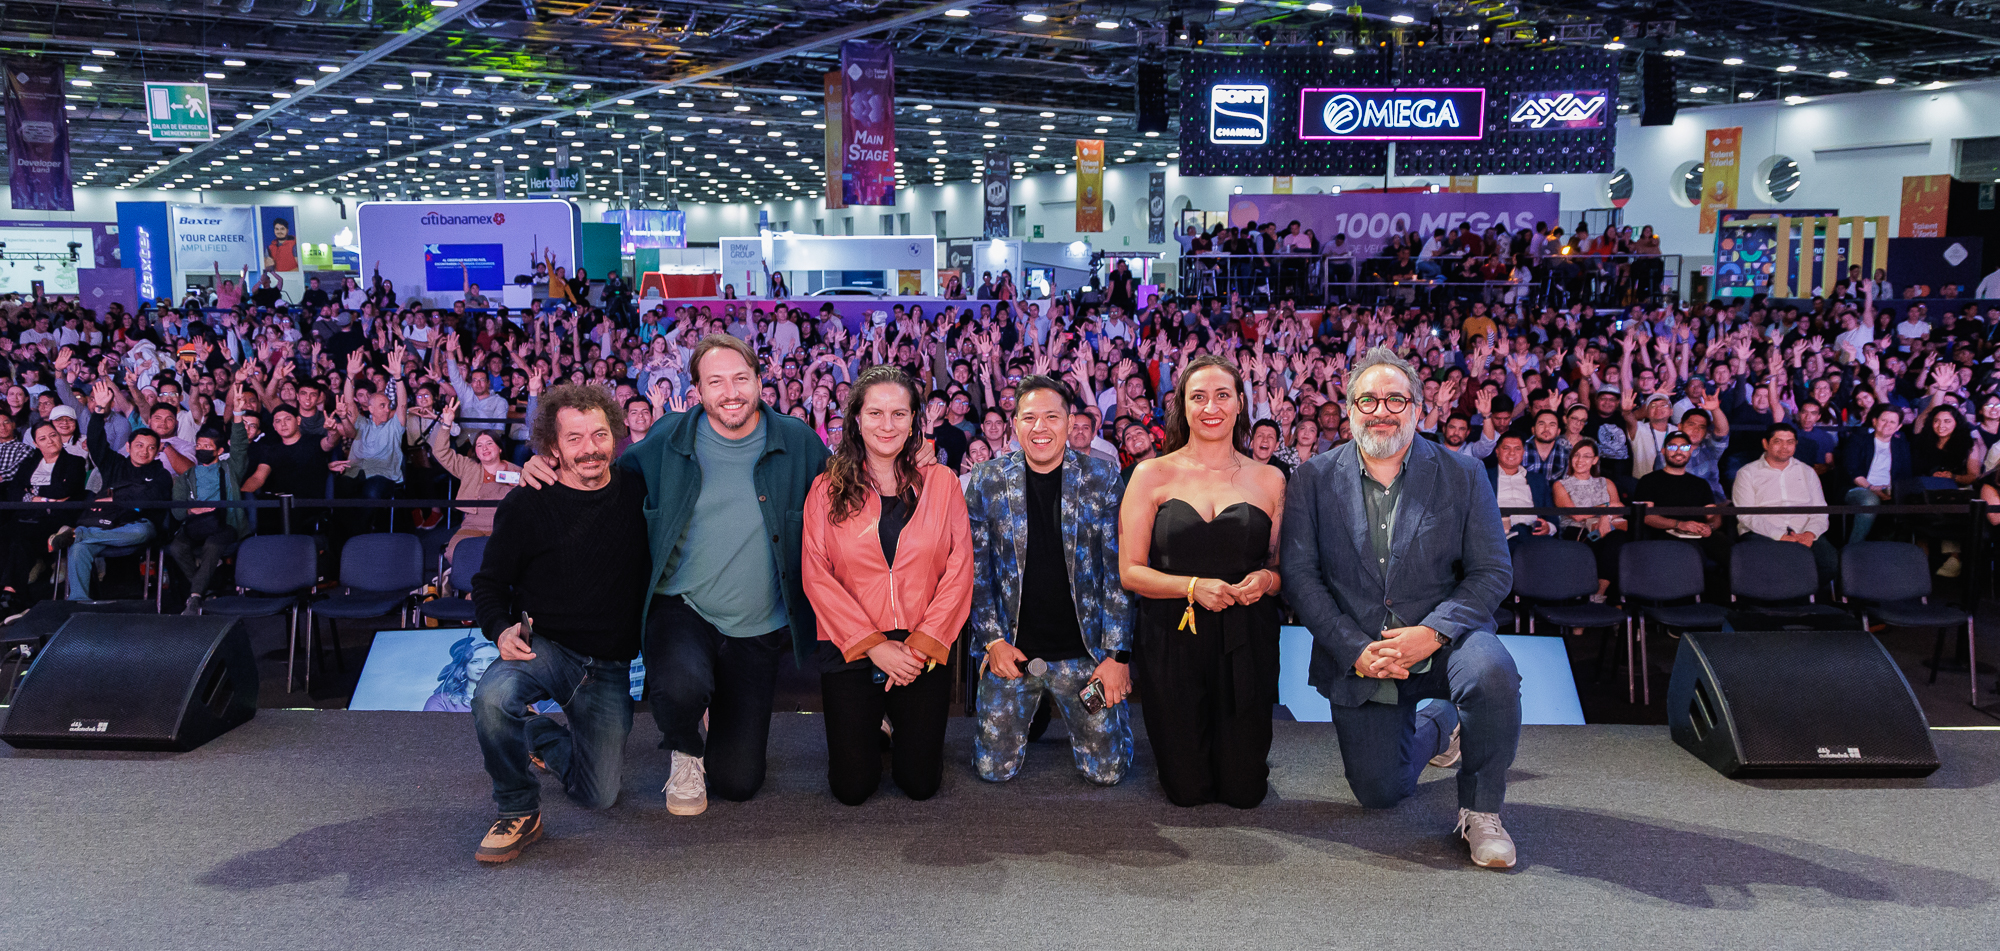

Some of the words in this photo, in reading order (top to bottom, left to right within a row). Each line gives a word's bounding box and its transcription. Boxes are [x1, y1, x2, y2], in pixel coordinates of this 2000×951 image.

[1215, 89, 1265, 104] SONY
[1362, 98, 1459, 128] MEGA
[1510, 93, 1606, 129] AXN
[853, 130, 884, 145] MAIN
[1215, 127, 1262, 138] CHANNEL
[848, 143, 890, 162] STAGE
[1710, 150, 1735, 158] Talent
[17, 158, 62, 168] Developer
[1080, 159, 1099, 167] Talent
[1709, 158, 1735, 167] World
[32, 166, 51, 174] Land
[530, 177, 576, 189] Herbalife
[179, 217, 222, 226] Baxter
[420, 211, 493, 226] citibanamex
[1335, 212, 1411, 239] 1000
[1913, 222, 1938, 230] Talent
[179, 234, 206, 242] YOUR
[208, 234, 247, 243] CAREER.
[730, 250, 755, 259] GROUP
[137, 226, 155, 300] Baxter
